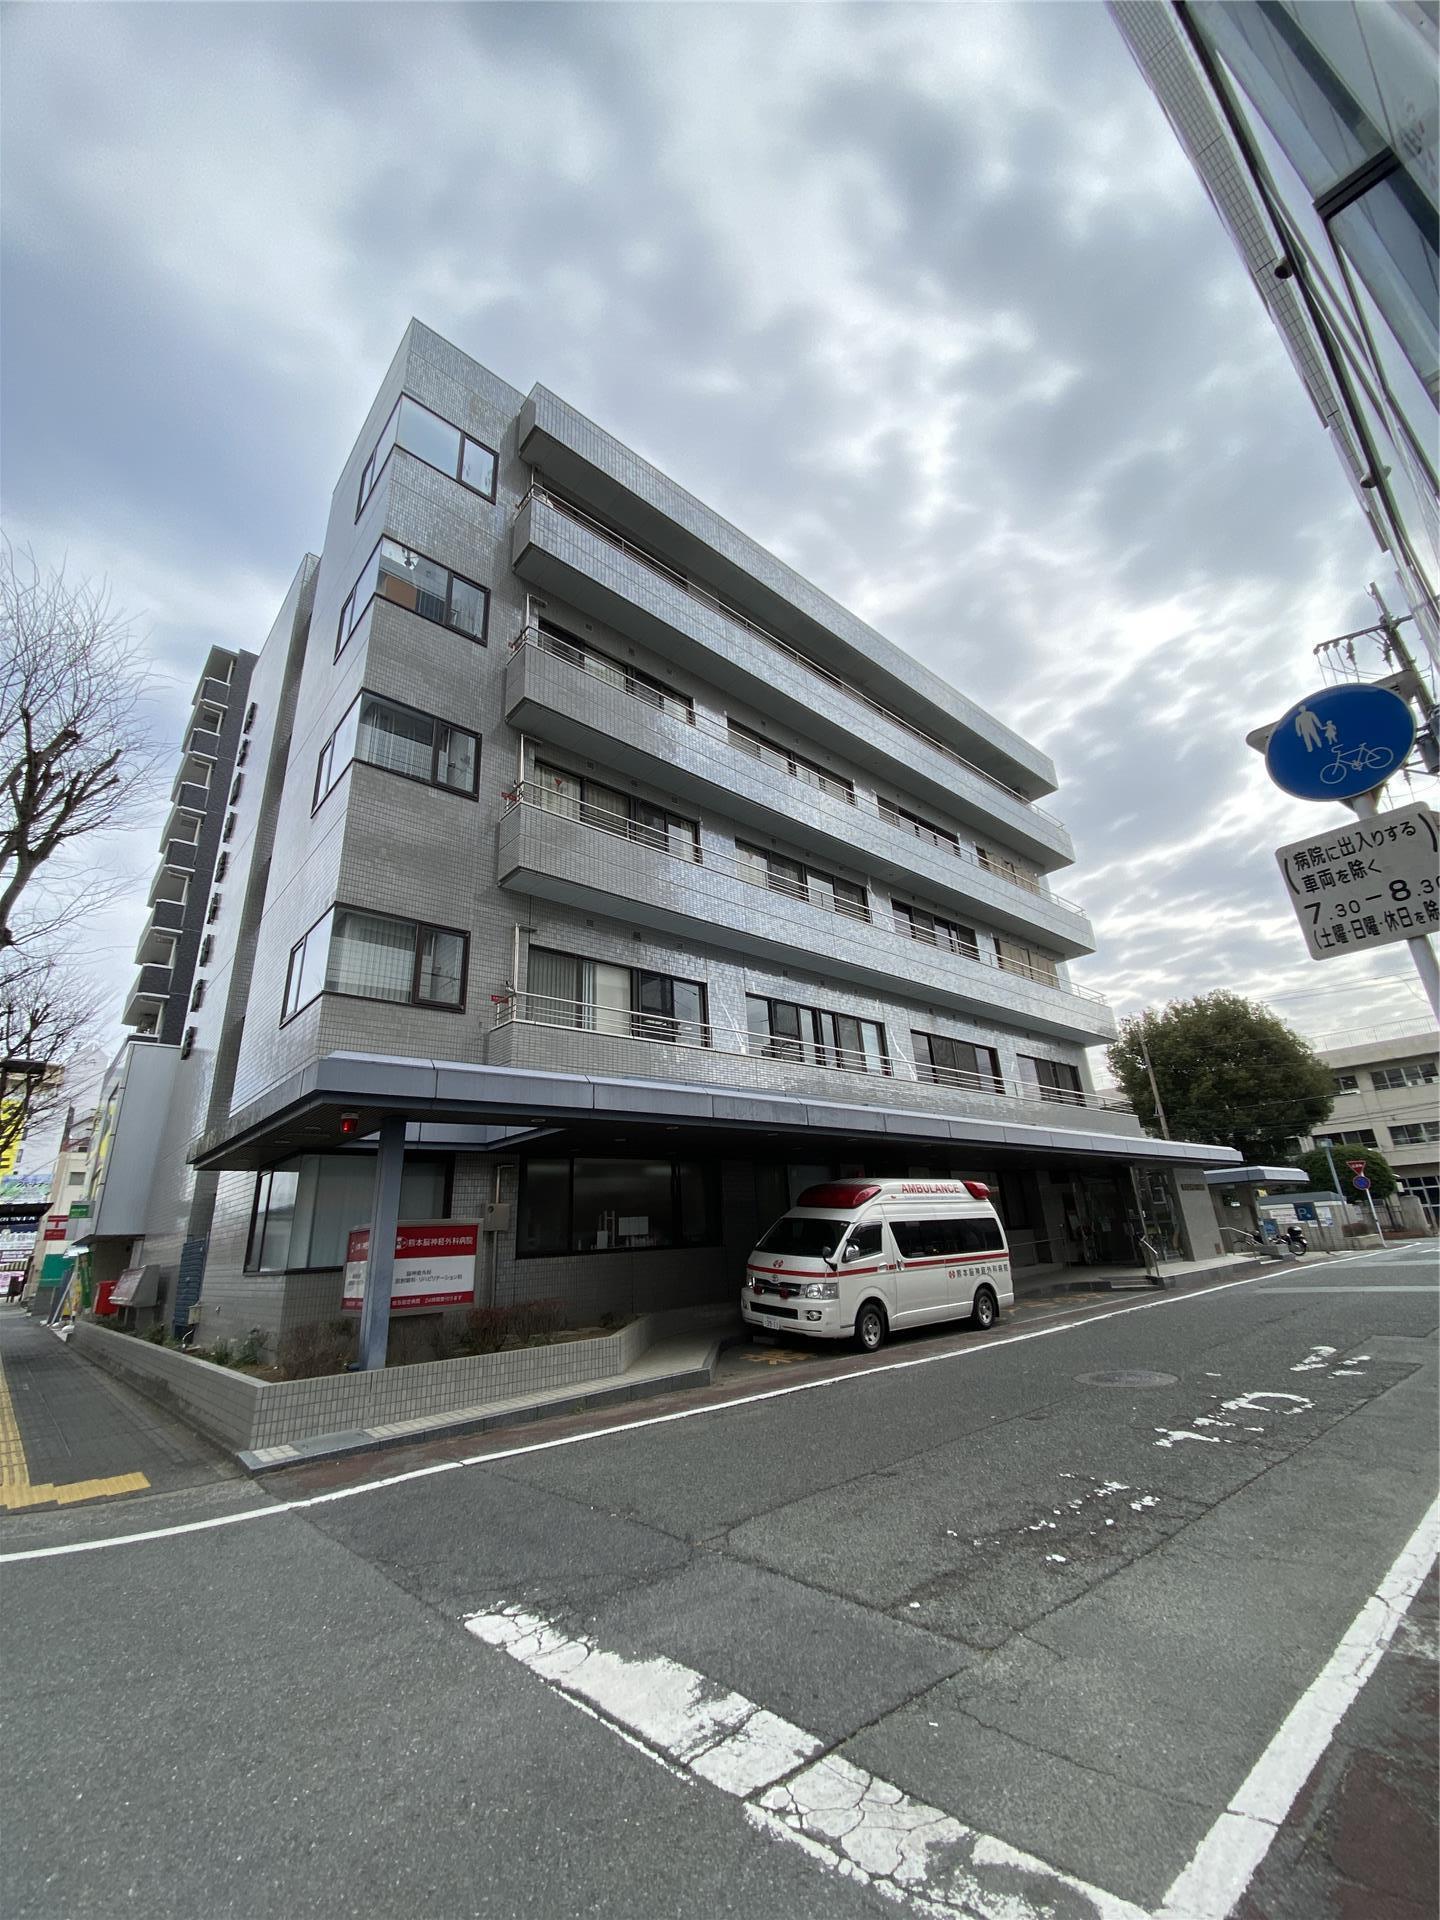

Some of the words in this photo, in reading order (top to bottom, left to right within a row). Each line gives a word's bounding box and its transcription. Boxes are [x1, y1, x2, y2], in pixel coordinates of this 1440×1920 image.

[1293, 821, 1416, 871] 病院に出入りする
[1301, 859, 1383, 894] 車両を除く
[901, 1184, 961, 1194] AMBULANCE
